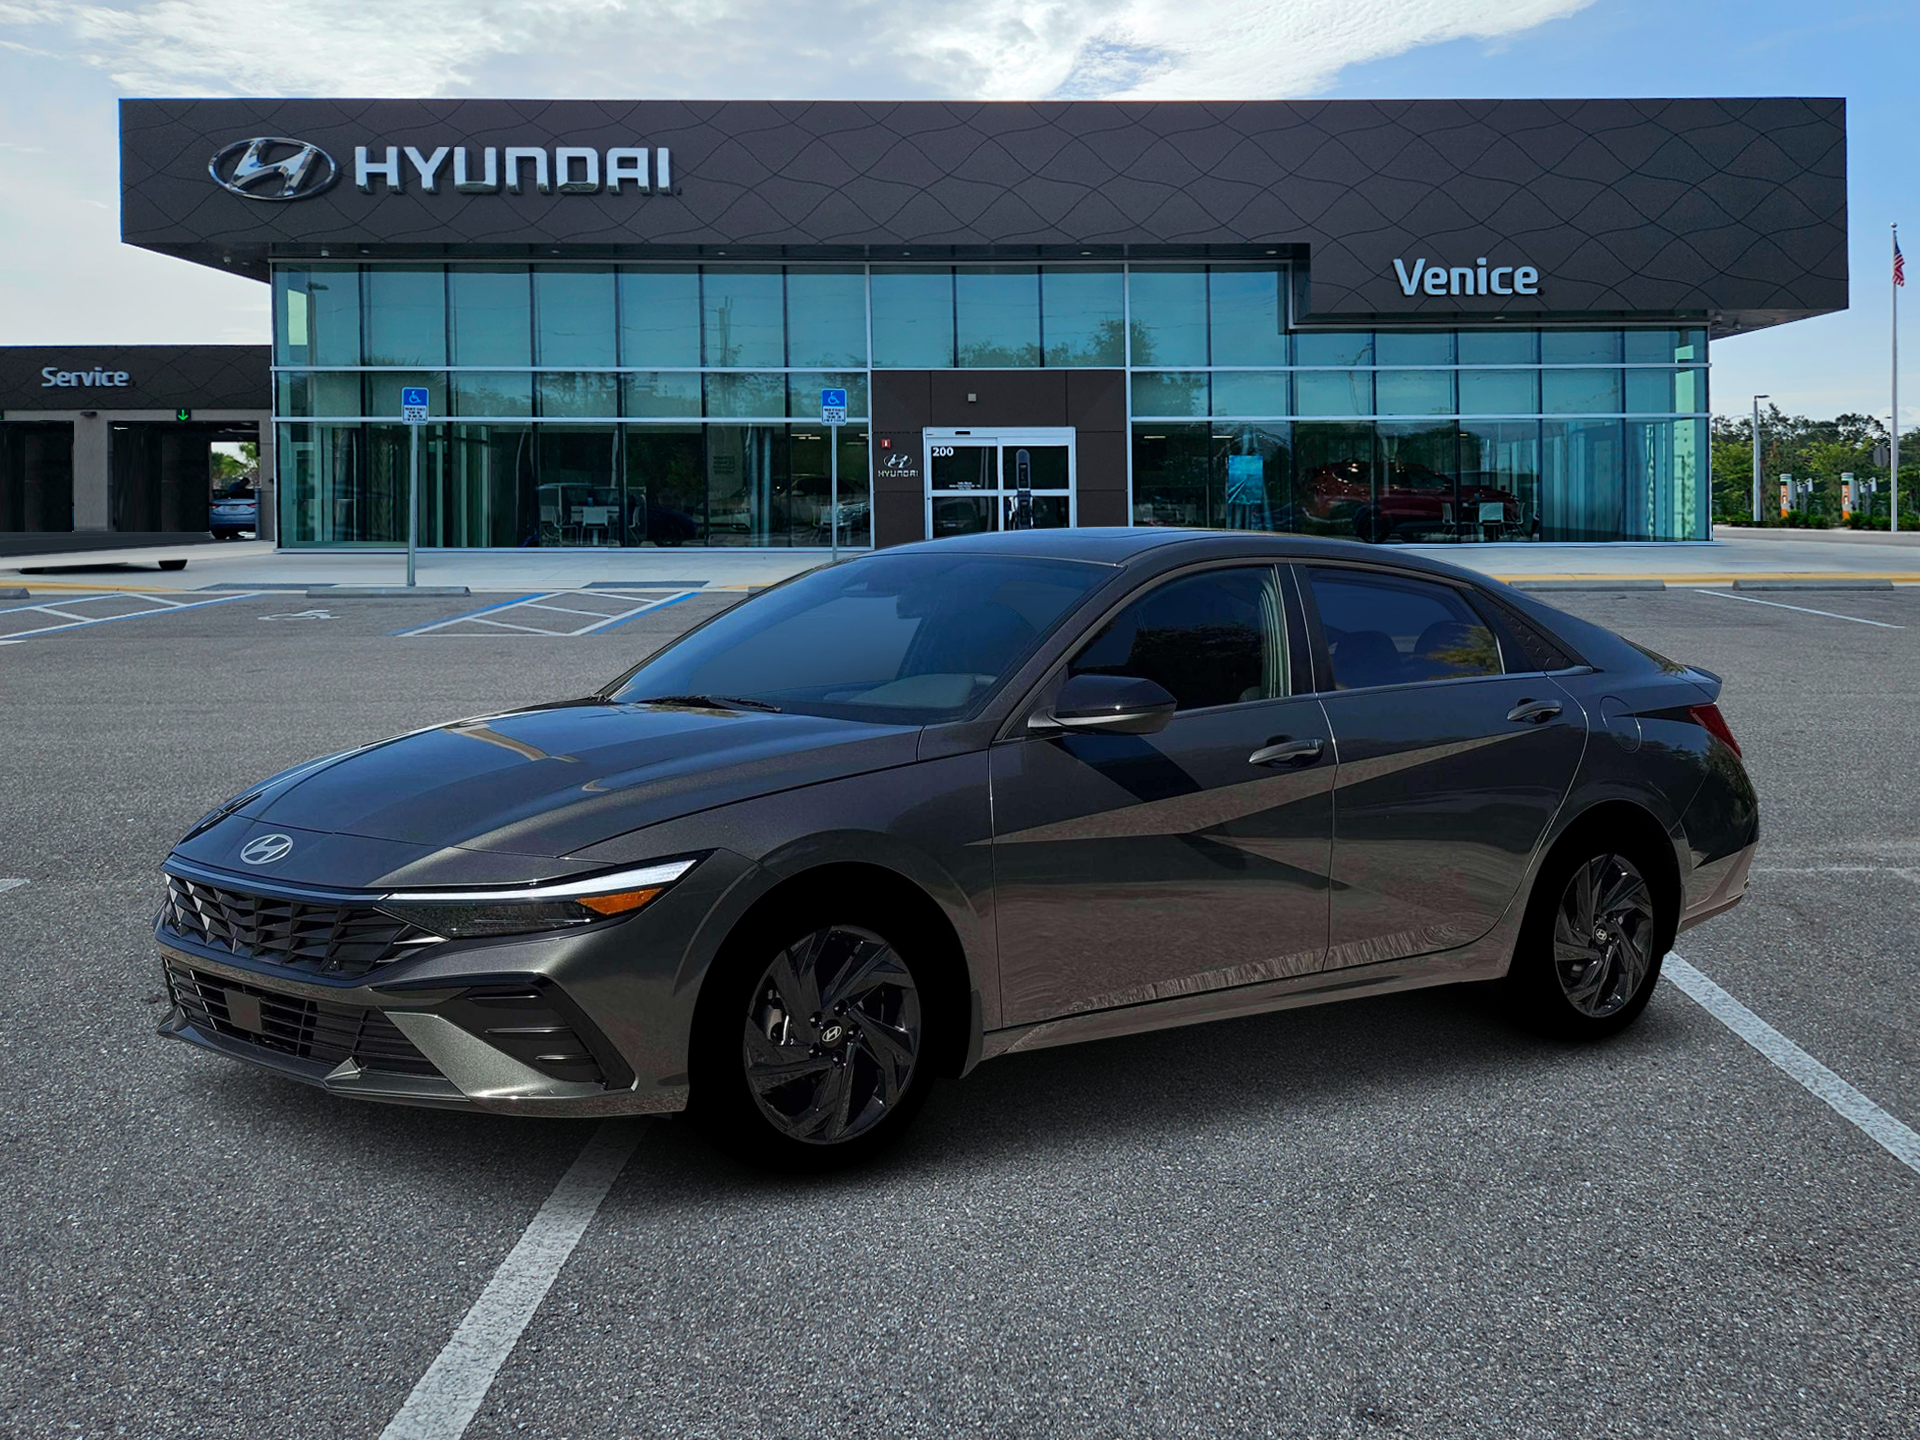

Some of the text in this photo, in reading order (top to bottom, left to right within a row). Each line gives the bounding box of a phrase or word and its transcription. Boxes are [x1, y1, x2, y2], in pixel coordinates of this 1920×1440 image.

[355, 146, 670, 194] HYUNDAI
[1392, 257, 1539, 296] Venice
[41, 366, 130, 387] Service
[932, 446, 954, 457] 200
[877, 469, 919, 478] HYUNDAI
